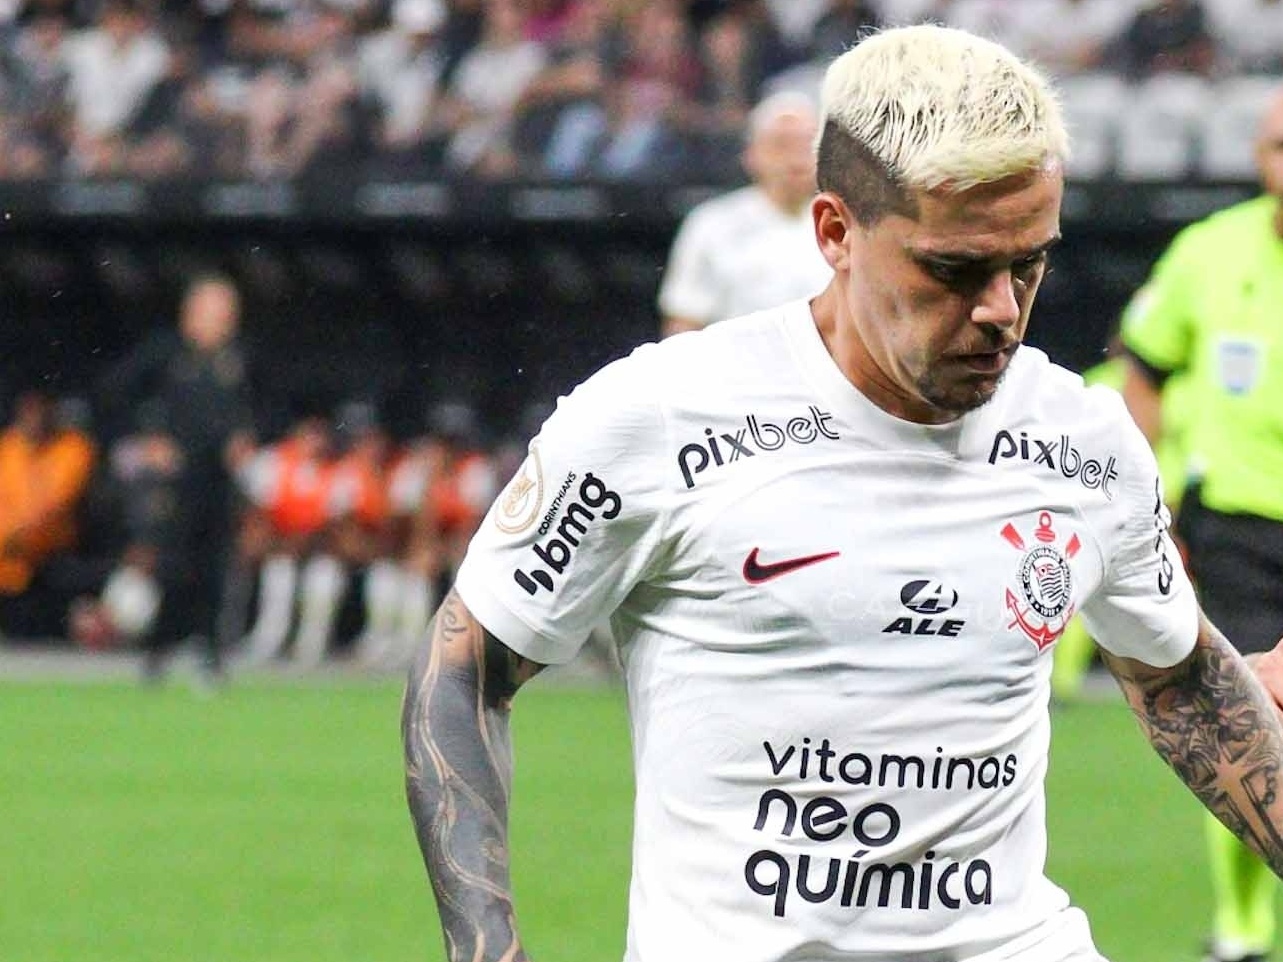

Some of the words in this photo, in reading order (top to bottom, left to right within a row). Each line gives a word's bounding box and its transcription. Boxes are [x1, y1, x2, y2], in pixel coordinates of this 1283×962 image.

[677, 405, 840, 489] pixbet
[987, 429, 1119, 501] pixbet
[532, 472, 622, 575] bmg
[538, 470, 577, 536] CORINTHIANS
[881, 616, 966, 637] ALE
[762, 737, 1018, 790] vitaminas
[752, 788, 901, 847] neo
[744, 849, 993, 918] química
